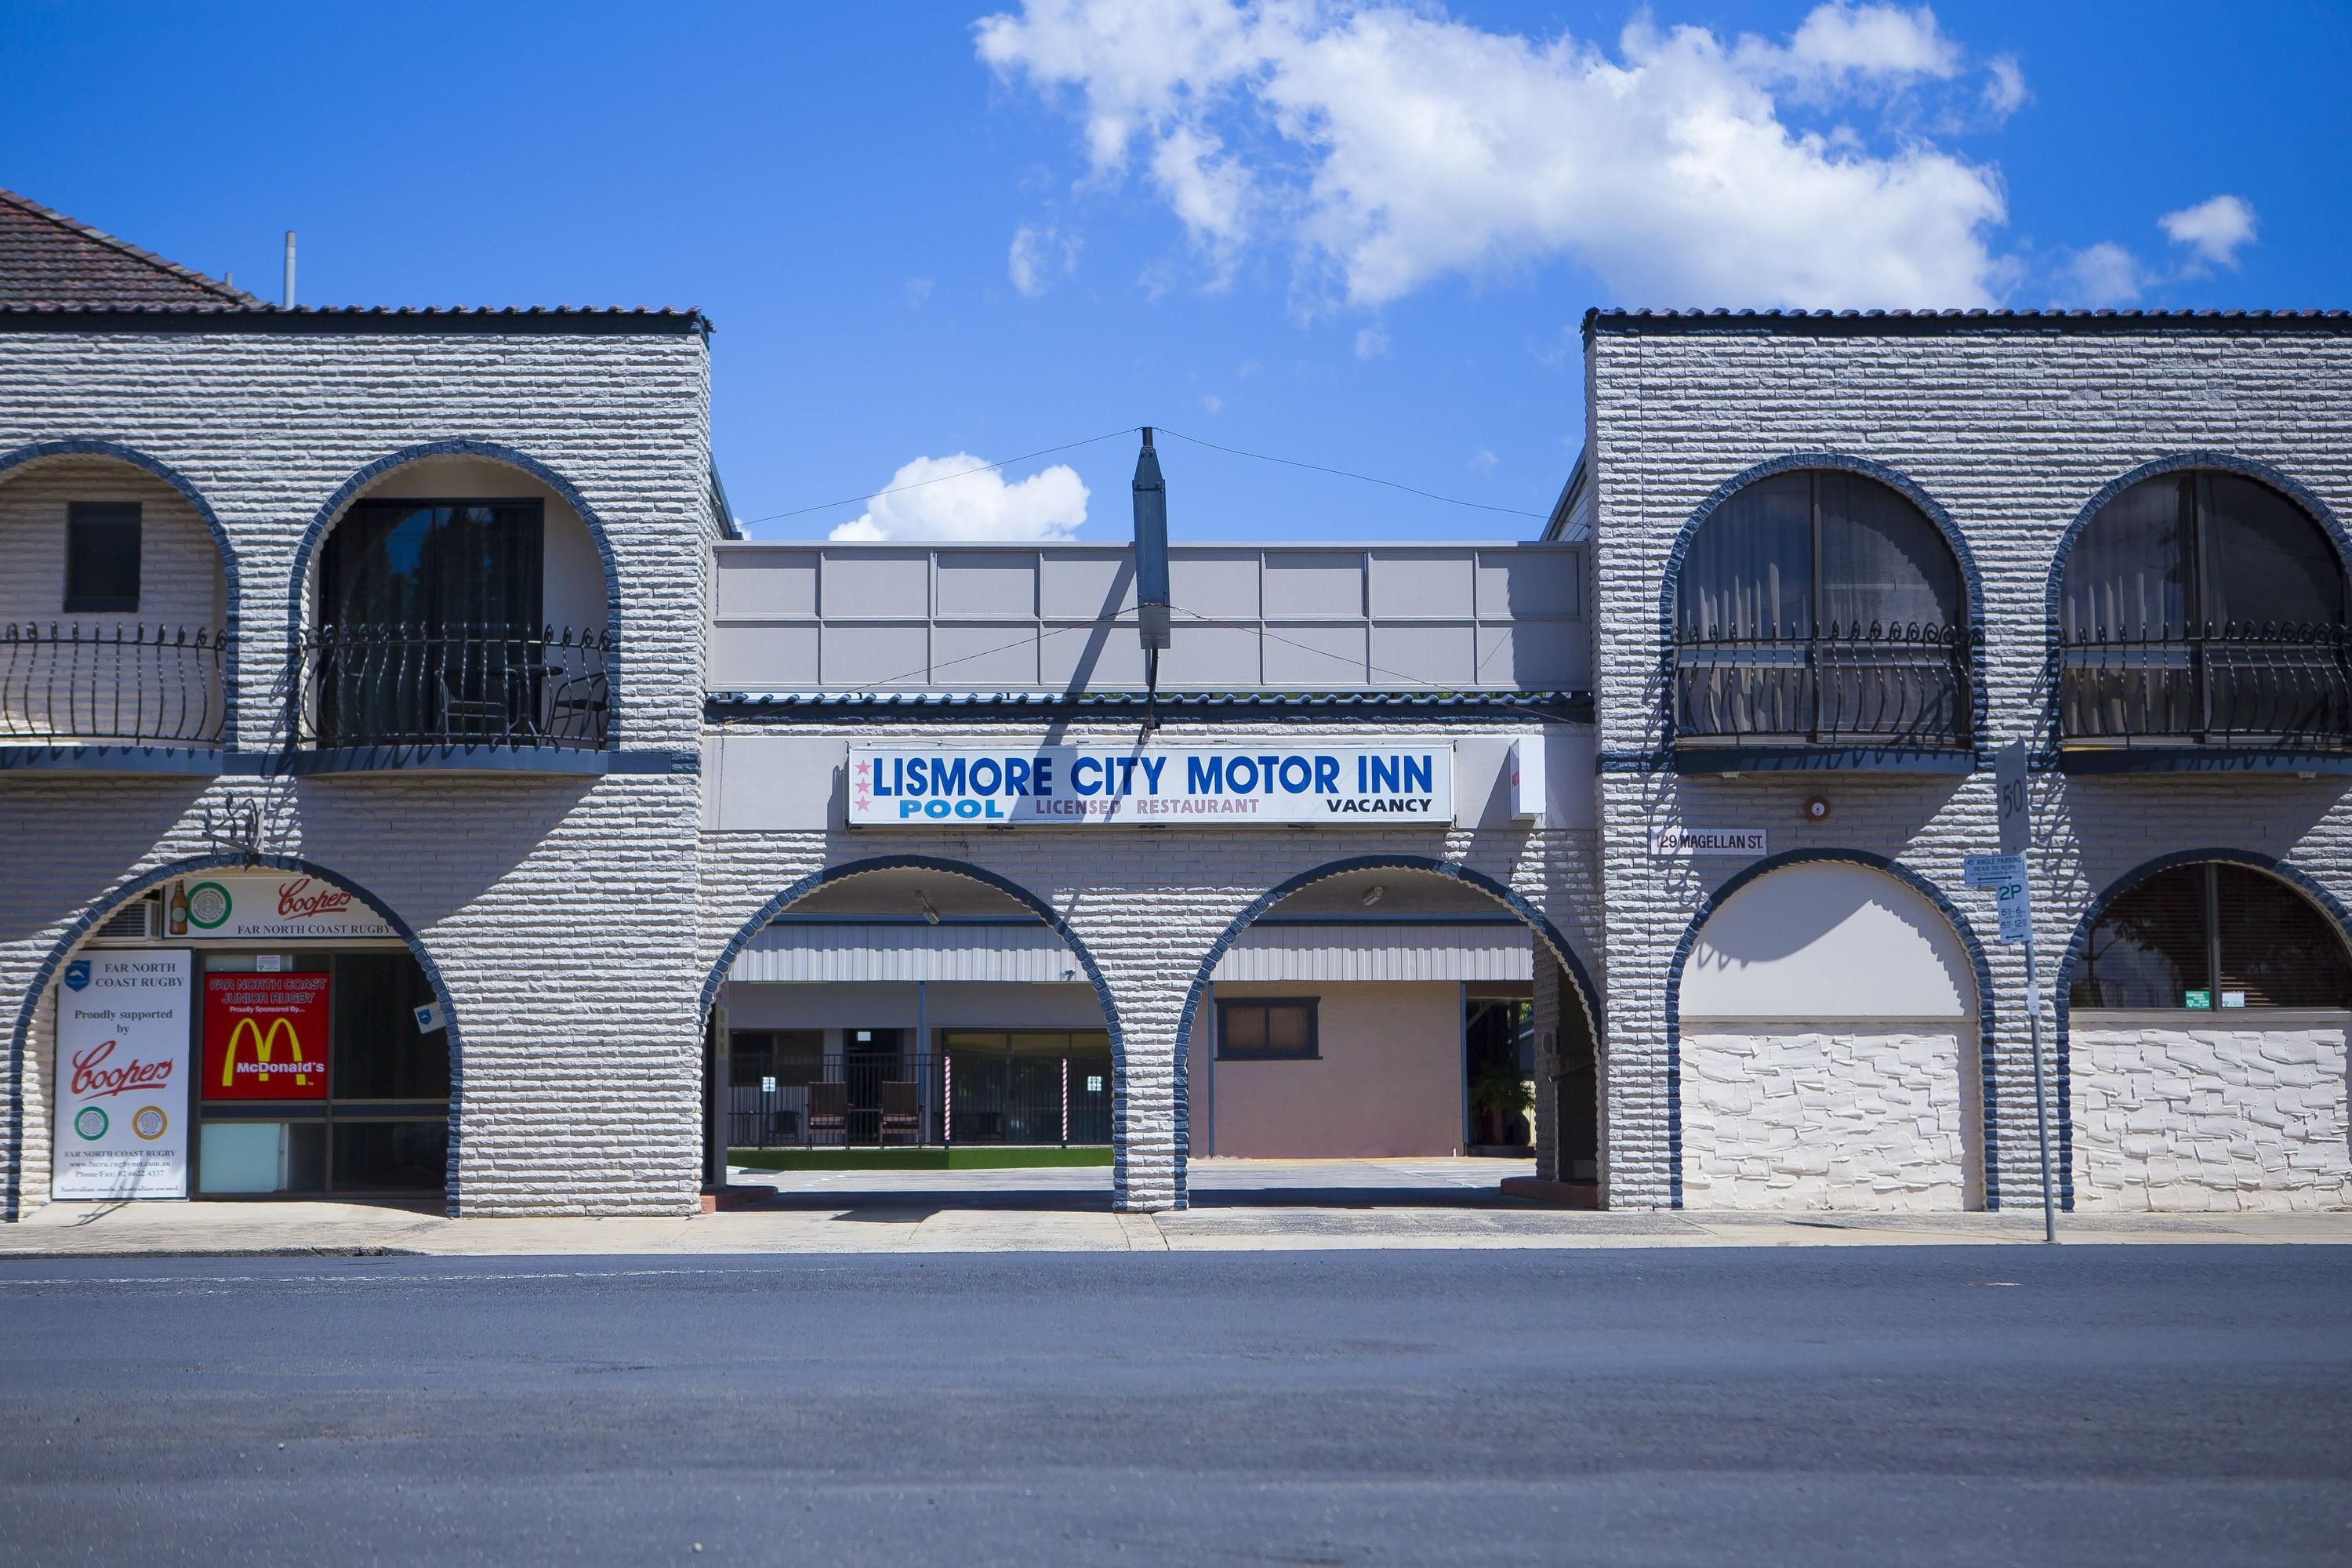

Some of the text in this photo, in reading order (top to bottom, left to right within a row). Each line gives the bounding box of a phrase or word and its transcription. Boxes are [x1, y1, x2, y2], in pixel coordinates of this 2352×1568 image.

[873, 755, 1432, 797] LISMORE CITY MOTOR INN
[1327, 798, 1432, 812] VACANCY
[2003, 779, 2023, 819] 50
[899, 799, 1004, 818] POOL
[1036, 798, 1260, 815] LICENSED RESTAURANT
[1657, 835, 1763, 849] 129 MAGELLAN ST.
[278, 878, 353, 919] Coopers
[1999, 884, 2022, 901] 2P
[238, 924, 391, 935] FAR NORTH COAST RUGBY
[105, 964, 176, 973] FAR NORTH
[95, 977, 185, 988] COAST RUGBY
[209, 978, 327, 990] FAR NORTH COAST
[221, 992, 315, 1004] JUNIOR RUGBY
[74, 1009, 172, 1022] Proudly supported
[117, 1024, 130, 1035] by
[71, 1040, 173, 1099] Coopers
[237, 1062, 325, 1073] McDonald's
